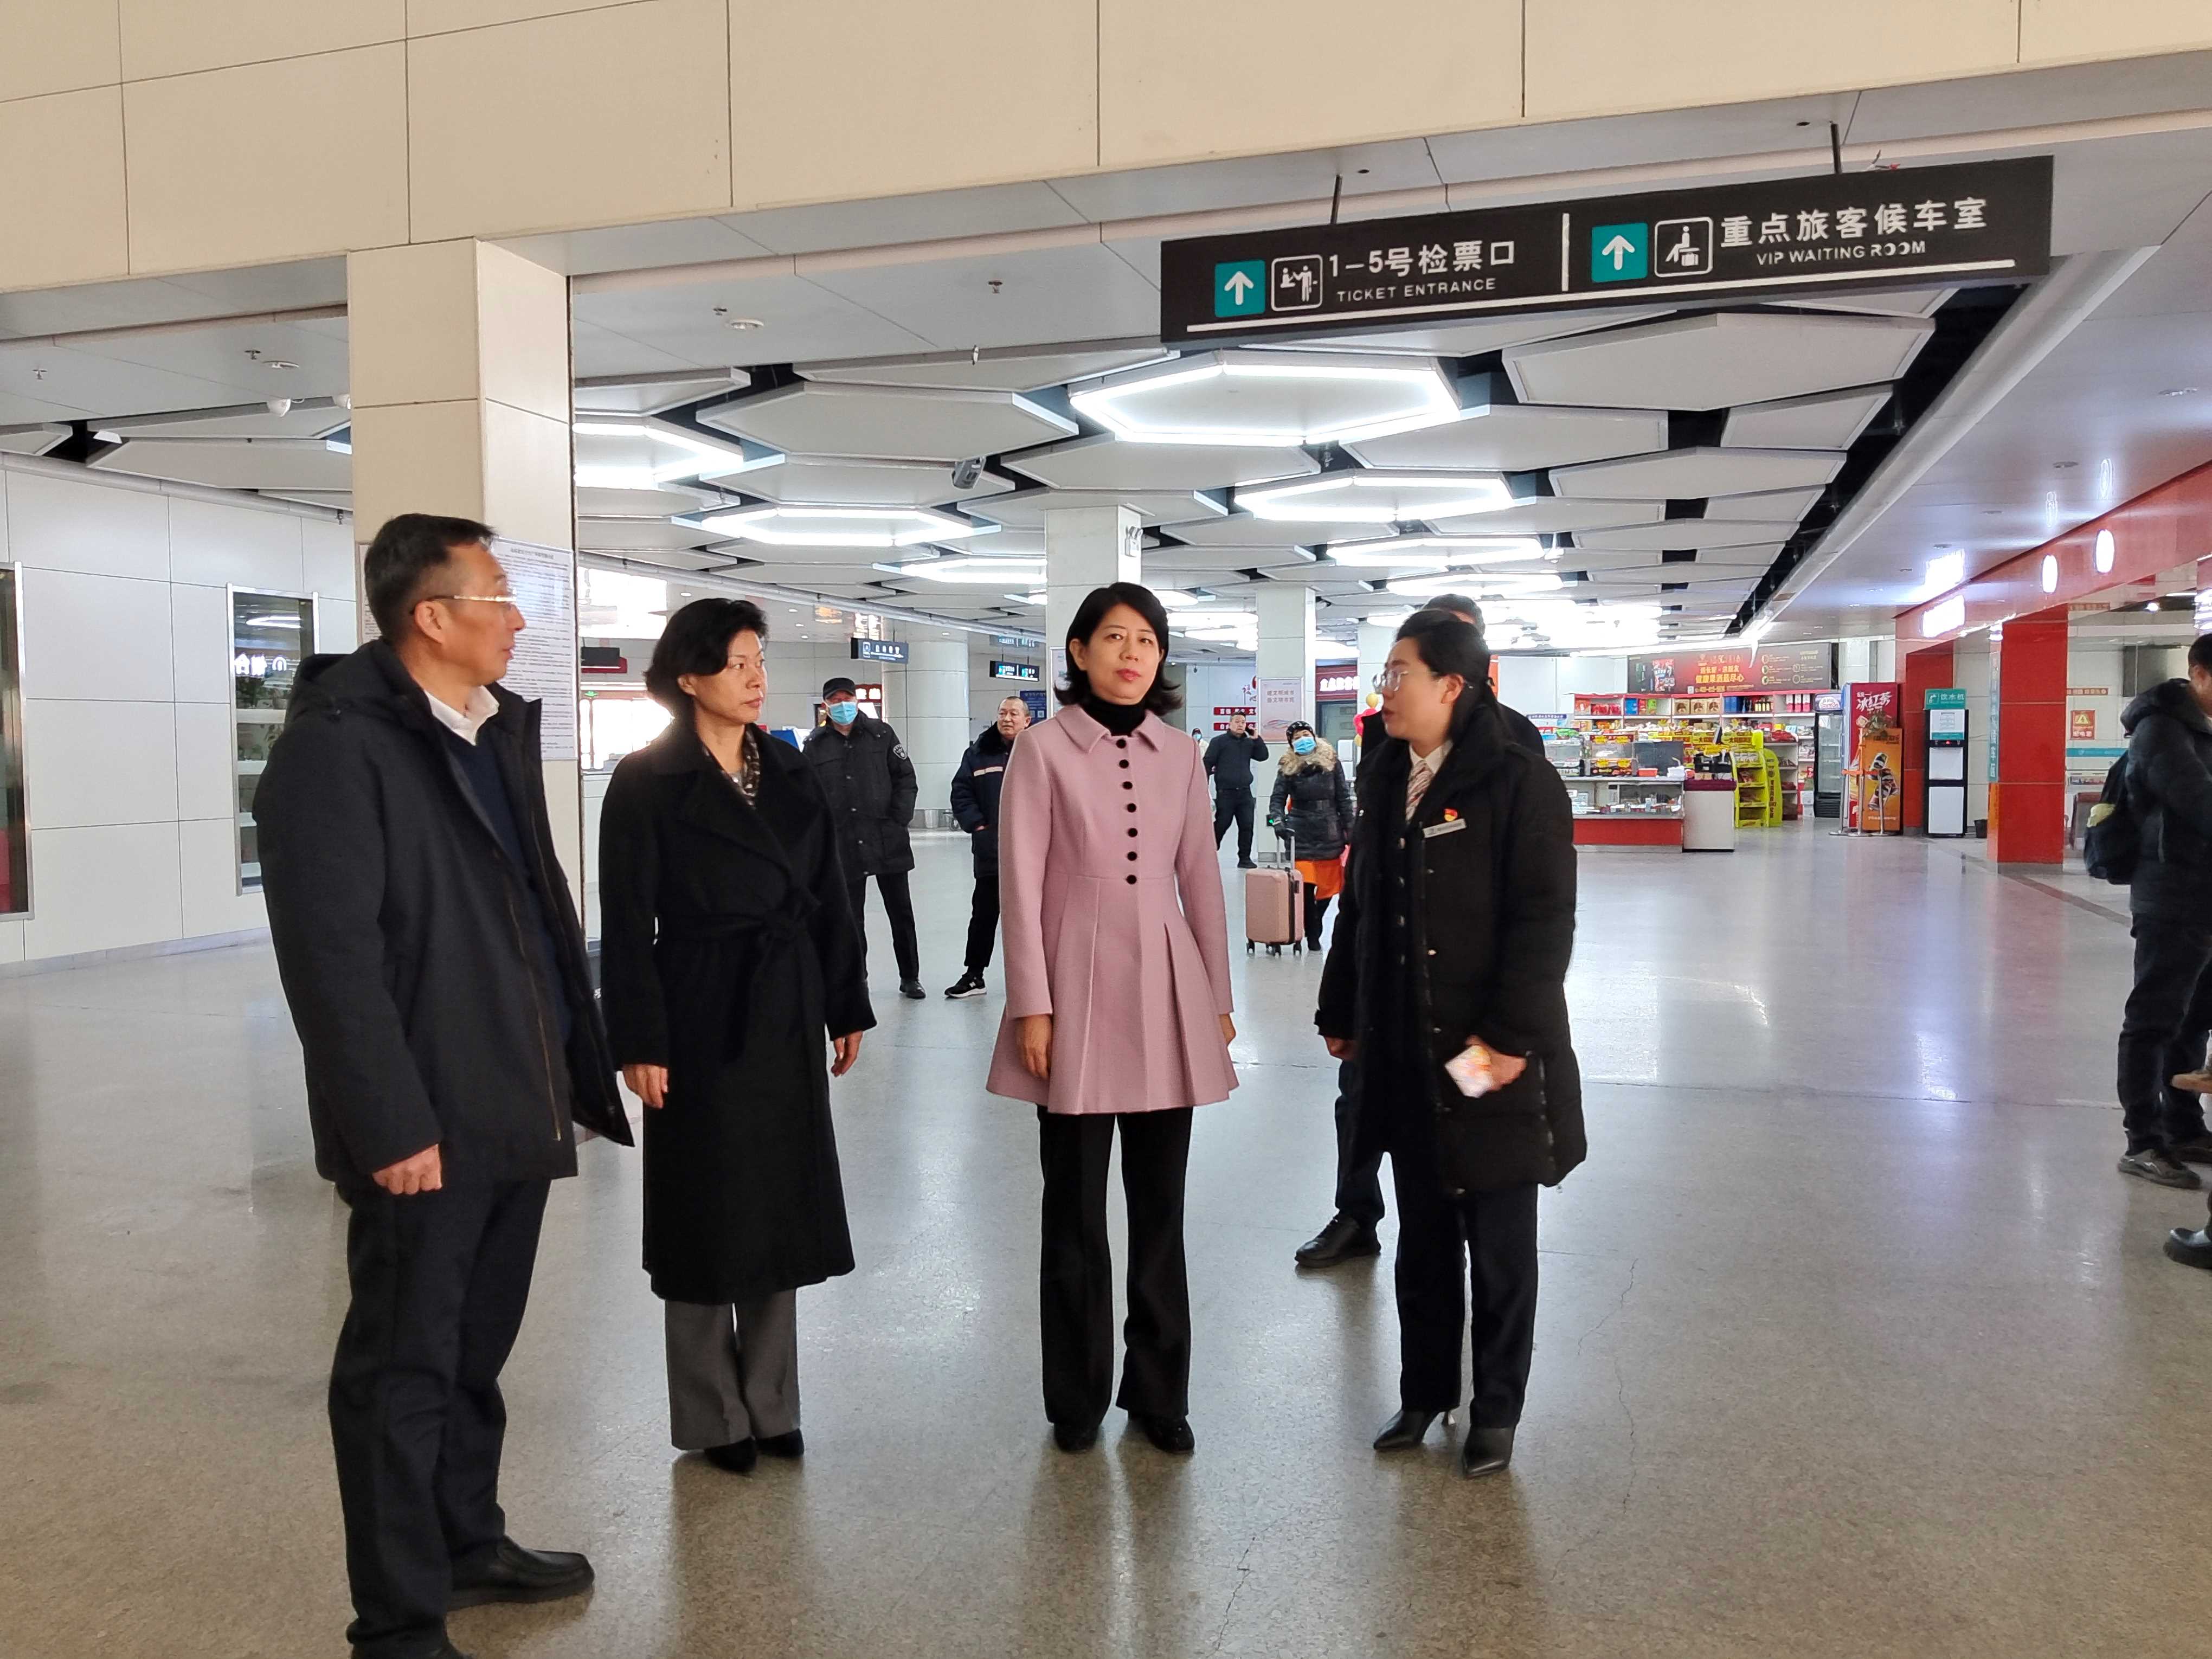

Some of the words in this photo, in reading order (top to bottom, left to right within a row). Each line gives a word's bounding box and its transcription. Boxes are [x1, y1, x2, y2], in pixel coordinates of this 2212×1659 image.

[1720, 196, 1988, 248] 重点旅客候车室
[1329, 240, 1515, 277] 1-5号检票口
[1756, 250, 1784, 266] VIP
[1789, 245, 1866, 264] WAITING
[1870, 240, 1926, 258] ROOM
[1337, 286, 1397, 303] TICKET
[1404, 278, 1497, 298] ENTRANCE
[1856, 691, 1892, 712] 冰红茶
